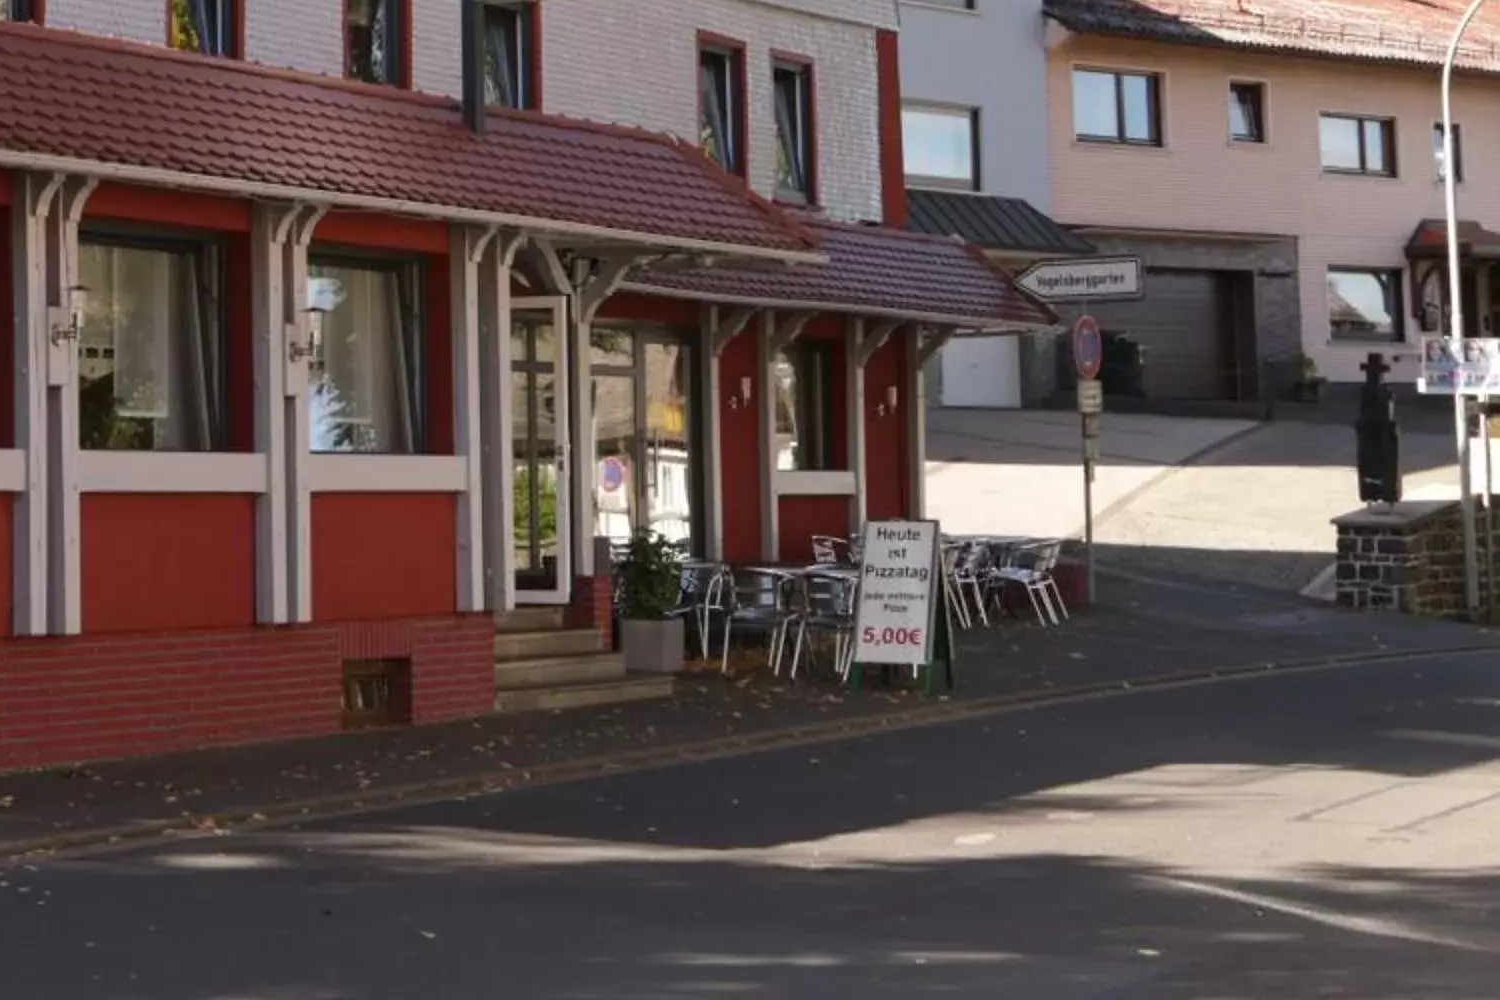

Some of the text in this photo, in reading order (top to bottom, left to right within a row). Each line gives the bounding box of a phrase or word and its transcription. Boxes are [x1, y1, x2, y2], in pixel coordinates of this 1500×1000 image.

[1035, 272, 1125, 290] Vogelsberggarten
[876, 527, 922, 541] Heute
[888, 548, 907, 559] ist
[865, 564, 929, 582] Pizzatag
[863, 626, 922, 647] 5,00€
